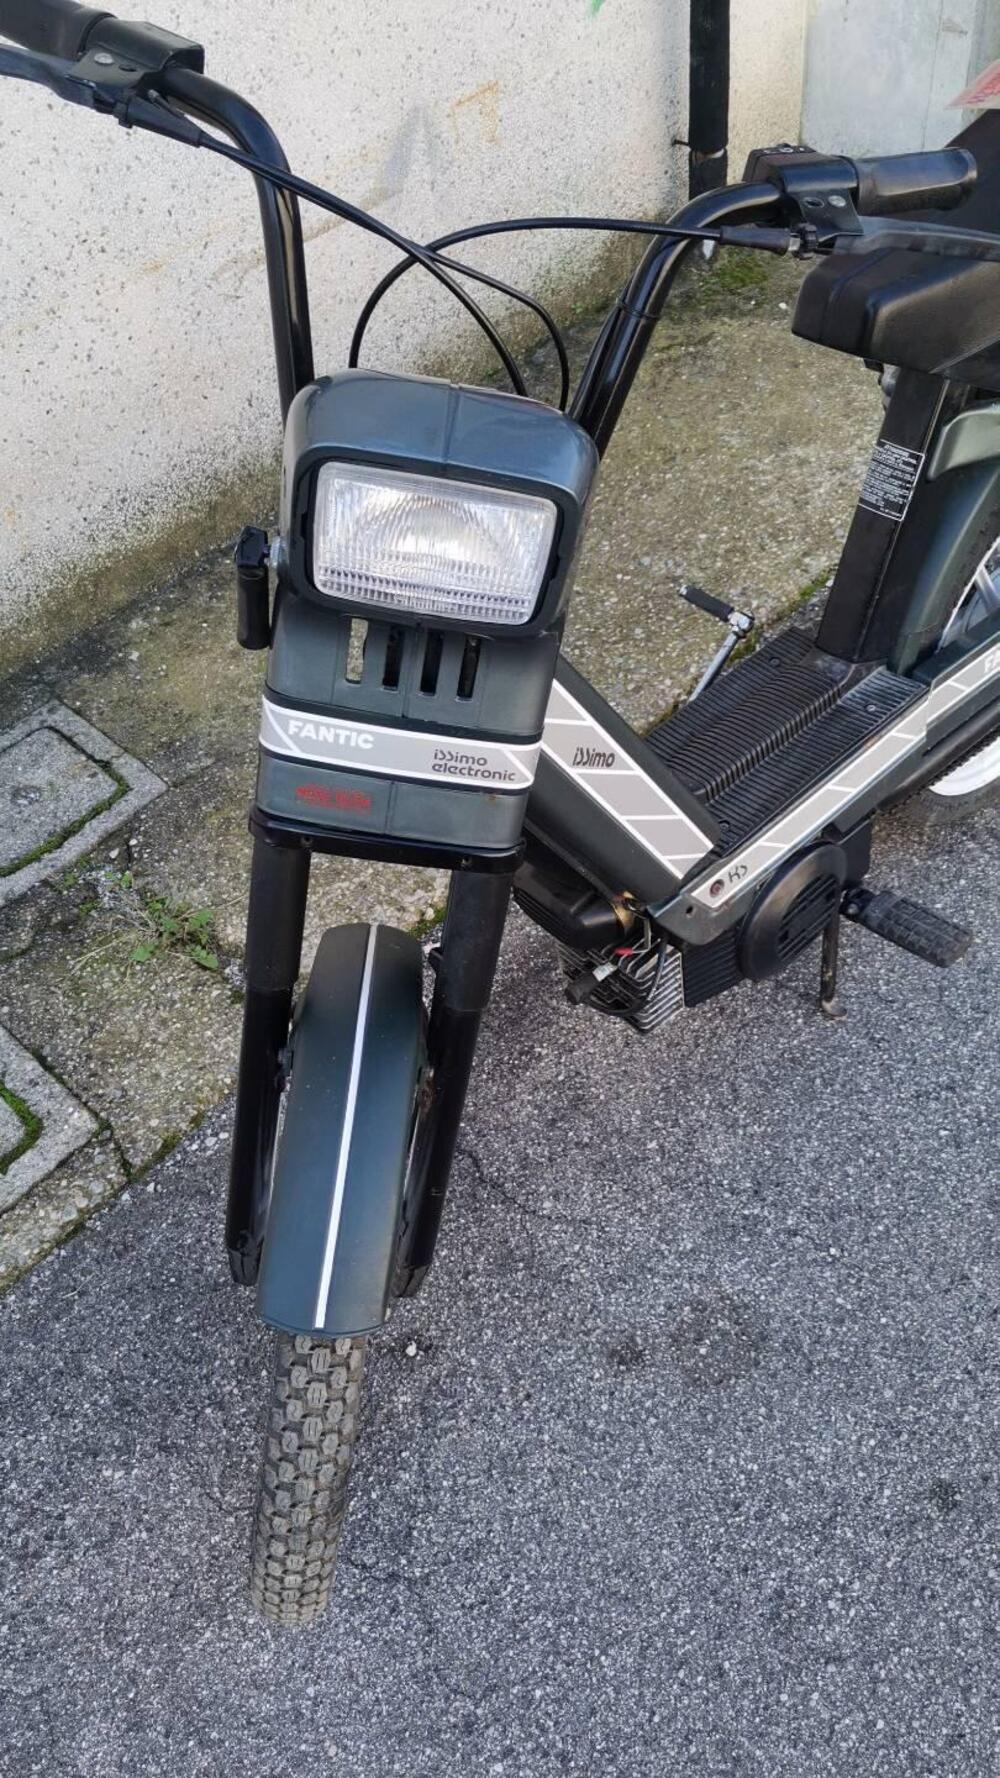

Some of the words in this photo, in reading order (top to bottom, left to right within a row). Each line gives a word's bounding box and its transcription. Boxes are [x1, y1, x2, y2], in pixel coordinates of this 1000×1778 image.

[287, 720, 374, 750] FANTIC
[433, 748, 488, 767] issimo
[572, 746, 616, 769] issimo
[431, 761, 516, 782] electronic
